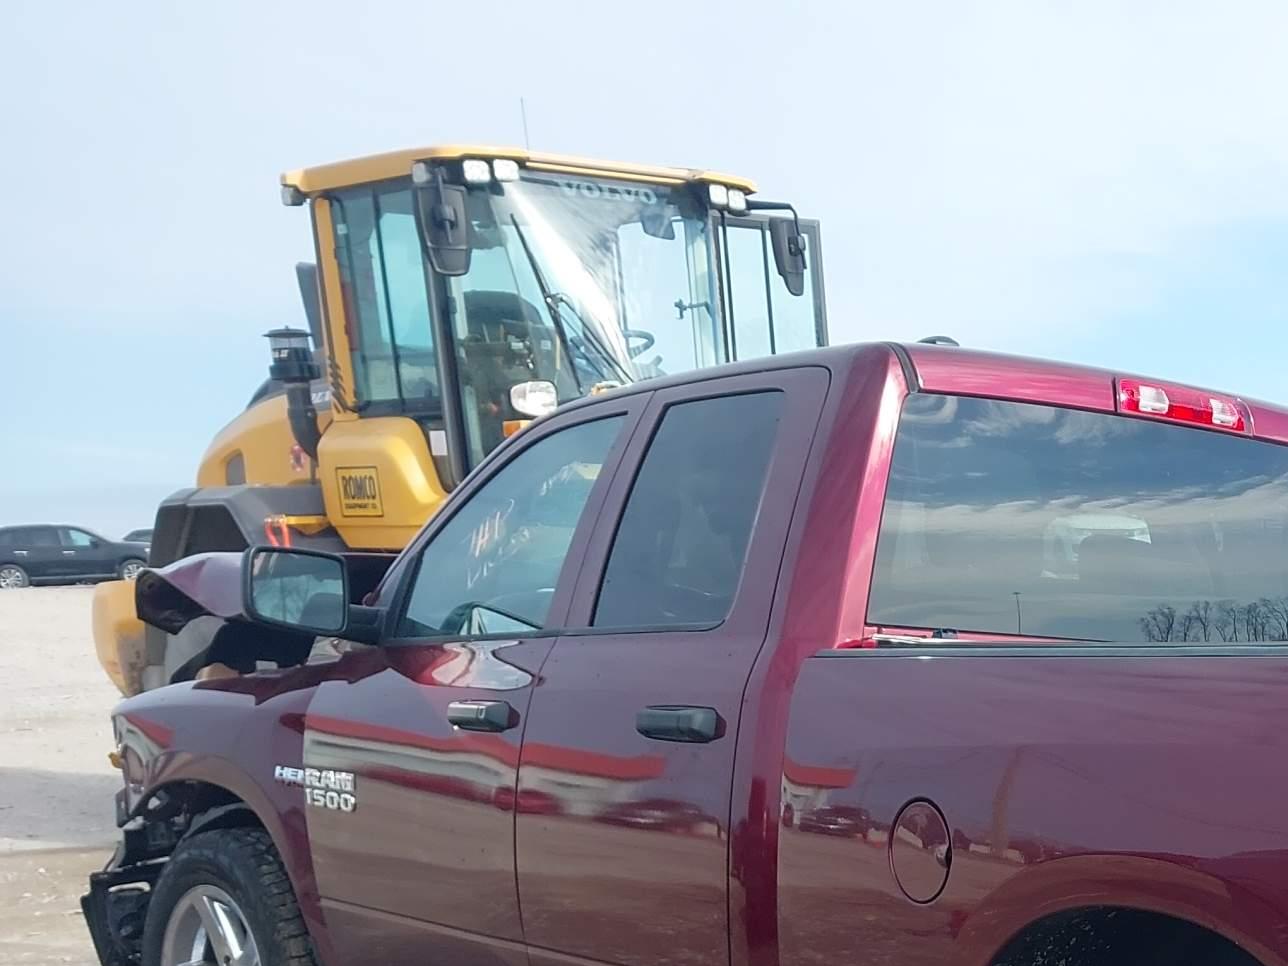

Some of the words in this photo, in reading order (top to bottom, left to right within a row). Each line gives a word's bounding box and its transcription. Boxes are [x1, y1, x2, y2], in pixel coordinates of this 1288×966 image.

[560, 181, 657, 204] VOLVO
[342, 475, 376, 500] ROMCO
[305, 767, 355, 792] RAM
[305, 788, 356, 812] 1500
